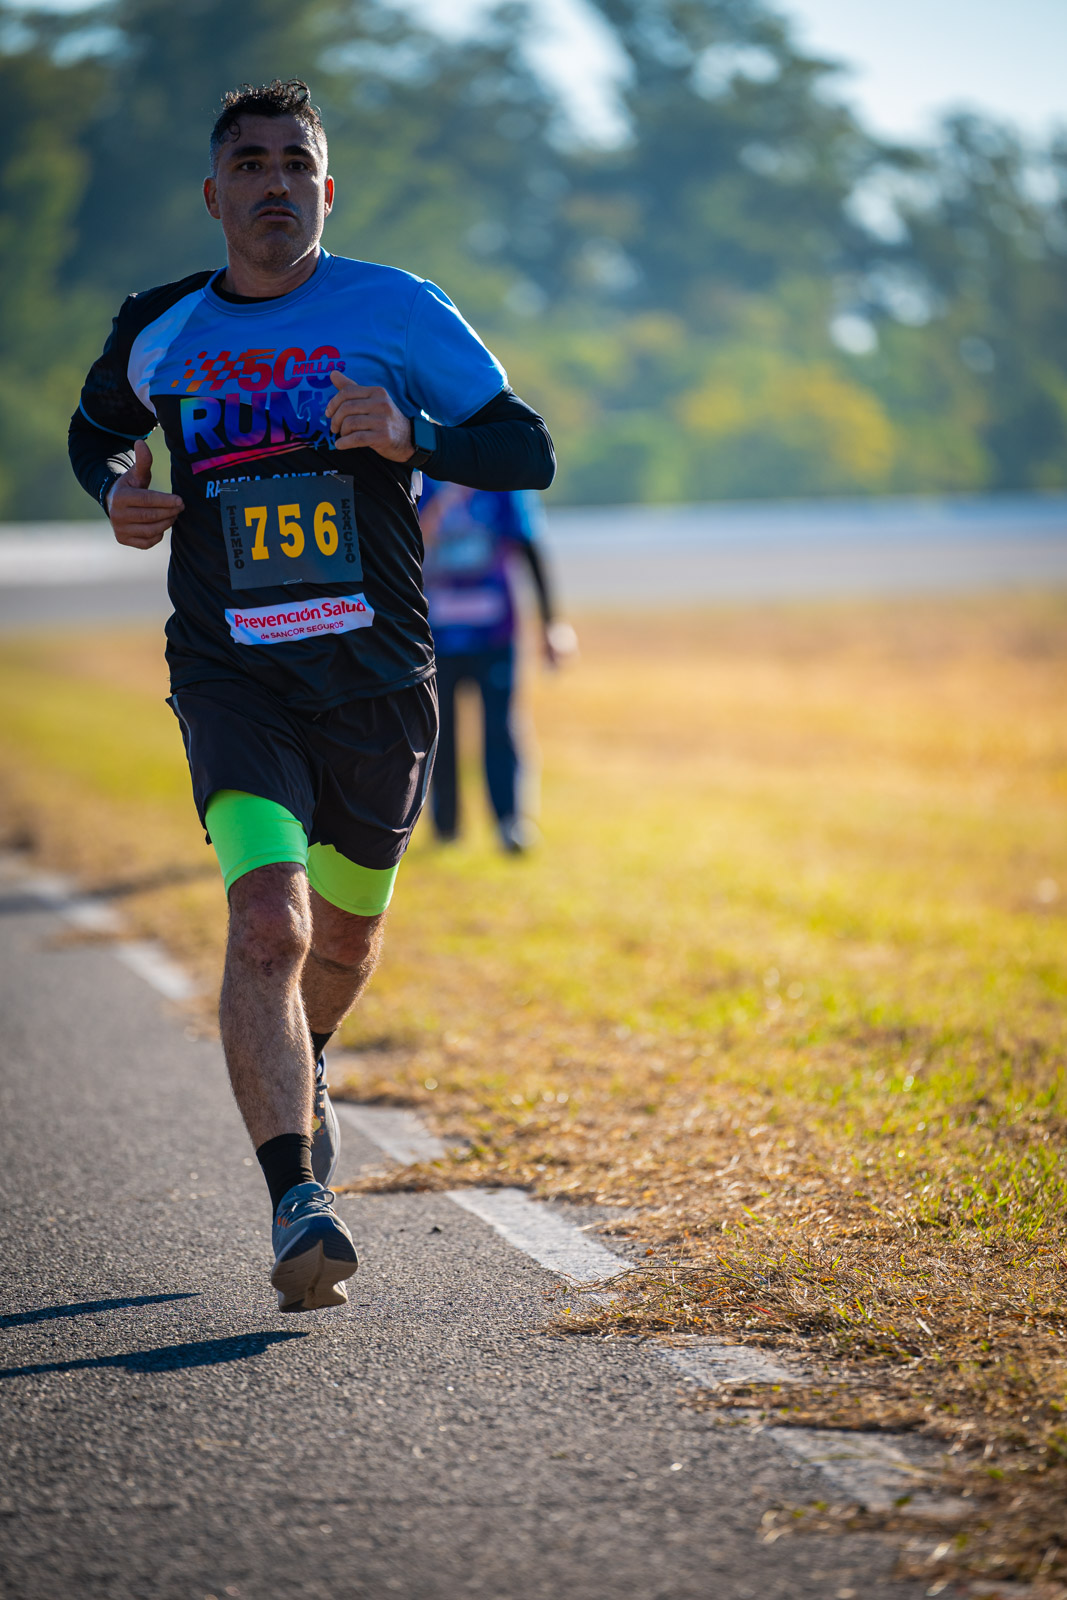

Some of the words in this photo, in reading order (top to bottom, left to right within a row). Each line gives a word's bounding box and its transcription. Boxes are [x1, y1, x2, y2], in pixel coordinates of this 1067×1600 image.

[237, 345, 340, 391] 500
[293, 361, 346, 376] MILLAS
[226, 505, 245, 569] TIEMPO
[244, 501, 339, 561] 756
[341, 499, 356, 564] EXACTO
[234, 607, 321, 629] Prevención
[321, 599, 366, 618] Salud
[271, 627, 305, 639] SANCOR
[306, 621, 344, 633] SEGUROS
